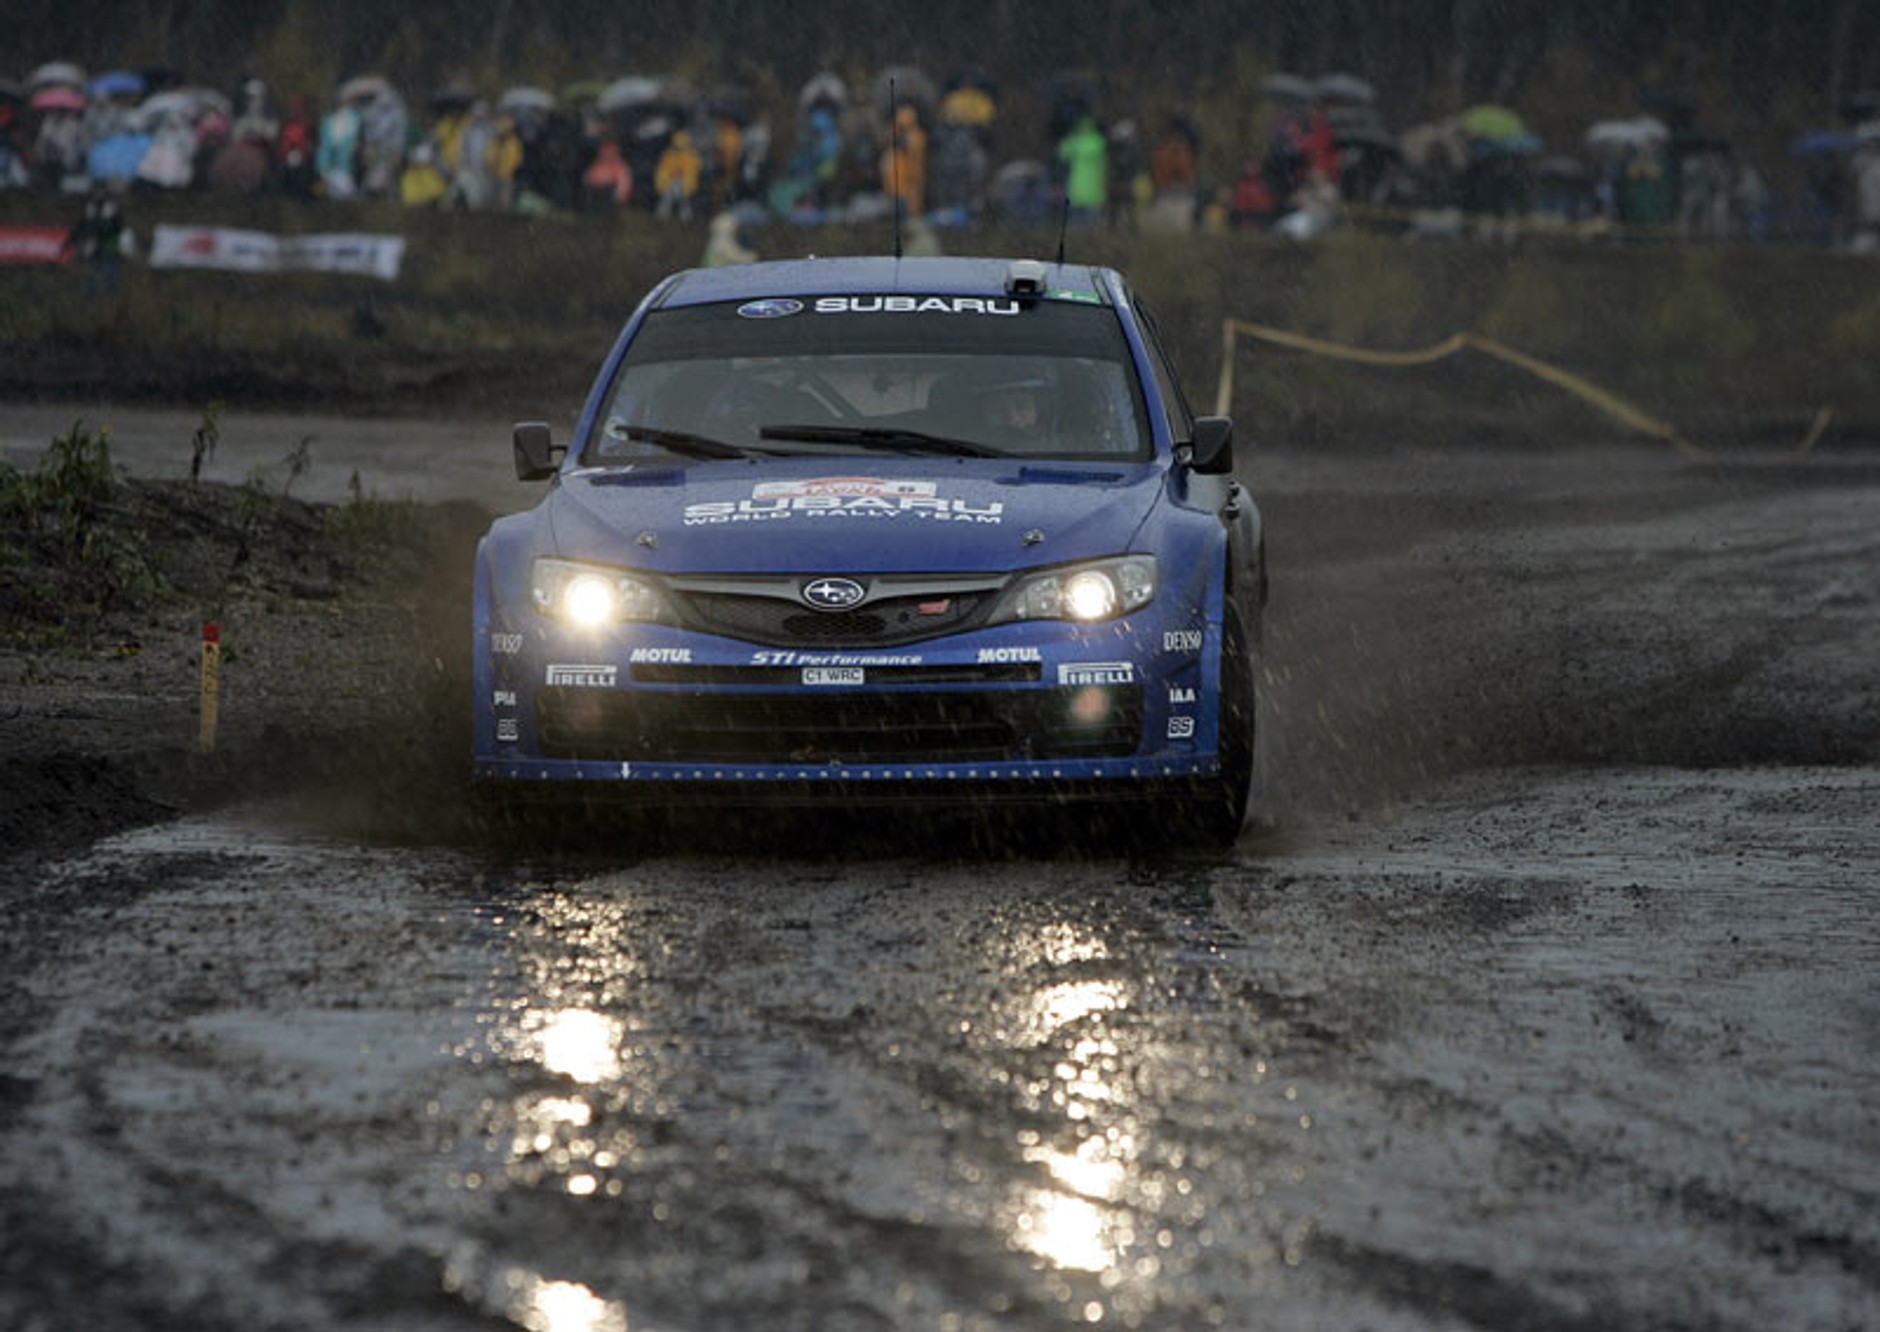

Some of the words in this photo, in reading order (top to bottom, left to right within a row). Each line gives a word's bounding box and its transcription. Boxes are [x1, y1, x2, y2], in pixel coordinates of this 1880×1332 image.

[814, 297, 1020, 314] SUBARU
[684, 497, 1004, 517] SUBARU
[684, 510, 791, 525] WORLD
[806, 507, 901, 517] RALLY
[917, 510, 1002, 523] TEAM
[629, 648, 692, 663] MOTUL
[751, 651, 796, 665] STI
[797, 653, 922, 665] Performance
[978, 648, 1042, 663] MOTUL
[546, 664, 618, 686] PIRELLI
[805, 670, 822, 681] C1
[827, 670, 861, 681] WRC
[1057, 662, 1134, 685] PIRELLI
